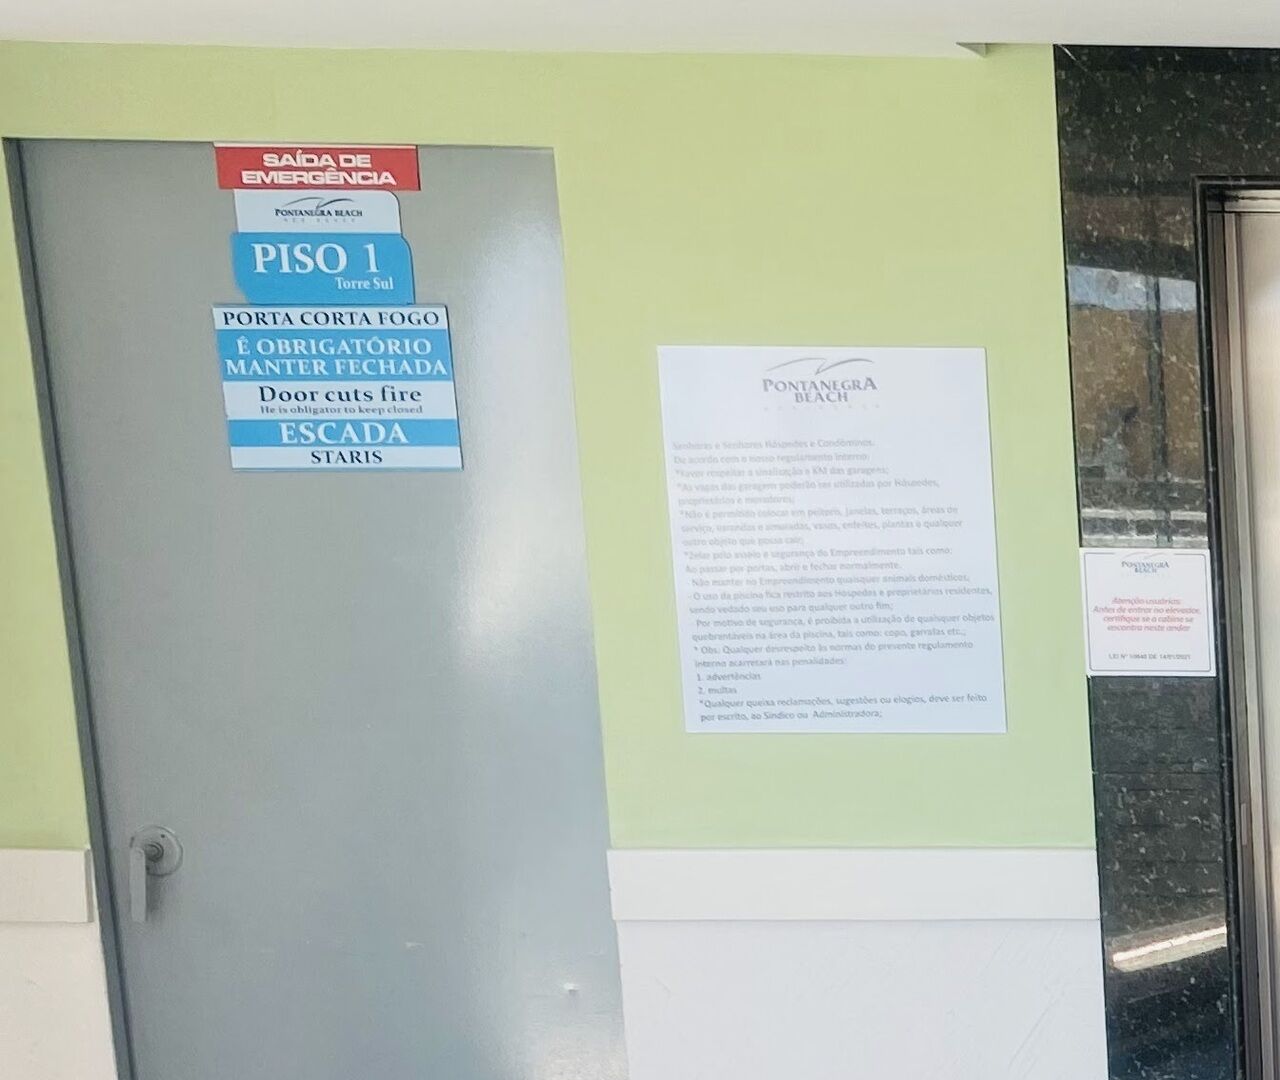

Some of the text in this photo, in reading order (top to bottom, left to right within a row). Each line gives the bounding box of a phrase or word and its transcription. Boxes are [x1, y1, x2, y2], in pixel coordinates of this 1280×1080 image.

[263, 150, 372, 168] SAÍDA DE
[241, 167, 397, 186] EMERGÊNCIA
[274, 208, 363, 217] PONTANEGRA BEACH
[251, 243, 380, 274] PISO 1
[335, 277, 394, 290] Torre Sul
[223, 311, 440, 326] PORTA CORTA FOGO
[256, 336, 432, 355] OBRIGATÓRIO
[225, 359, 448, 376] MANTER FECHADA
[762, 377, 878, 393] PONTANEGRA
[259, 386, 423, 402] Door cuts fire
[795, 391, 849, 403] BEACH
[261, 404, 423, 416] He is obligator to keep closed
[279, 422, 409, 445] ESCADA
[311, 450, 383, 464] STARIS
[701, 714, 715, 722] por
